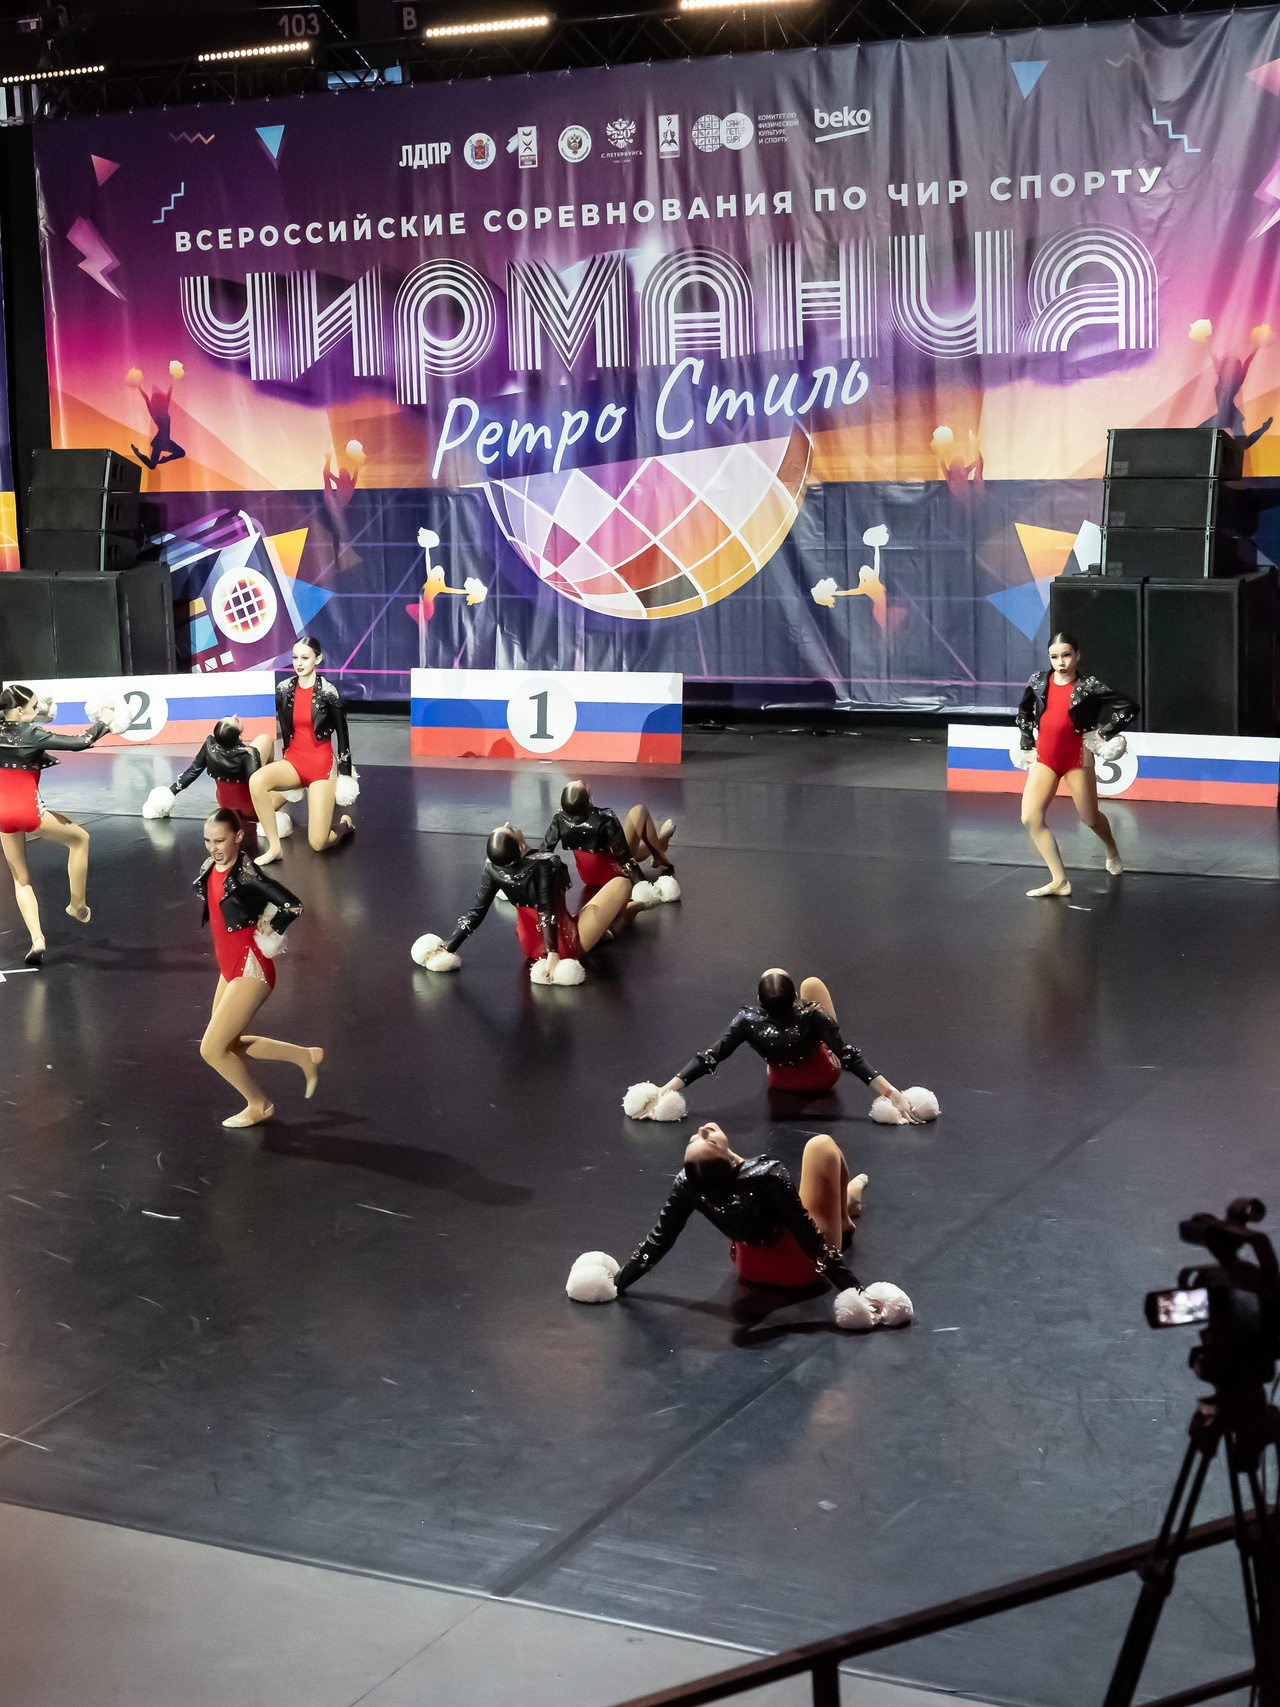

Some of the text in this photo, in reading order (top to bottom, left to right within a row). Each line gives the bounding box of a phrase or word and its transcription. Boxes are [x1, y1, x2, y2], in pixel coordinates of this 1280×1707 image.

[278, 13, 320, 37] 103
[758, 112, 786, 121] КОМИТЕТ
[758, 119, 799, 129] ФИЗИЧЕСКОЙ
[814, 106, 870, 128] beko
[758, 128, 787, 137] КУЛЬТУРЕ
[765, 136, 789, 144] СПОРТУ
[398, 141, 452, 170] ЛДПР
[175, 166, 1163, 253] ВСЕРОССИЙСКИЕ СОРЕВНОВАНИЯ ПО ЧИР СПОРТУ
[431, 357, 869, 480] Ретро Стиль
[123, 690, 152, 730] 2
[529, 691, 555, 739] 1
